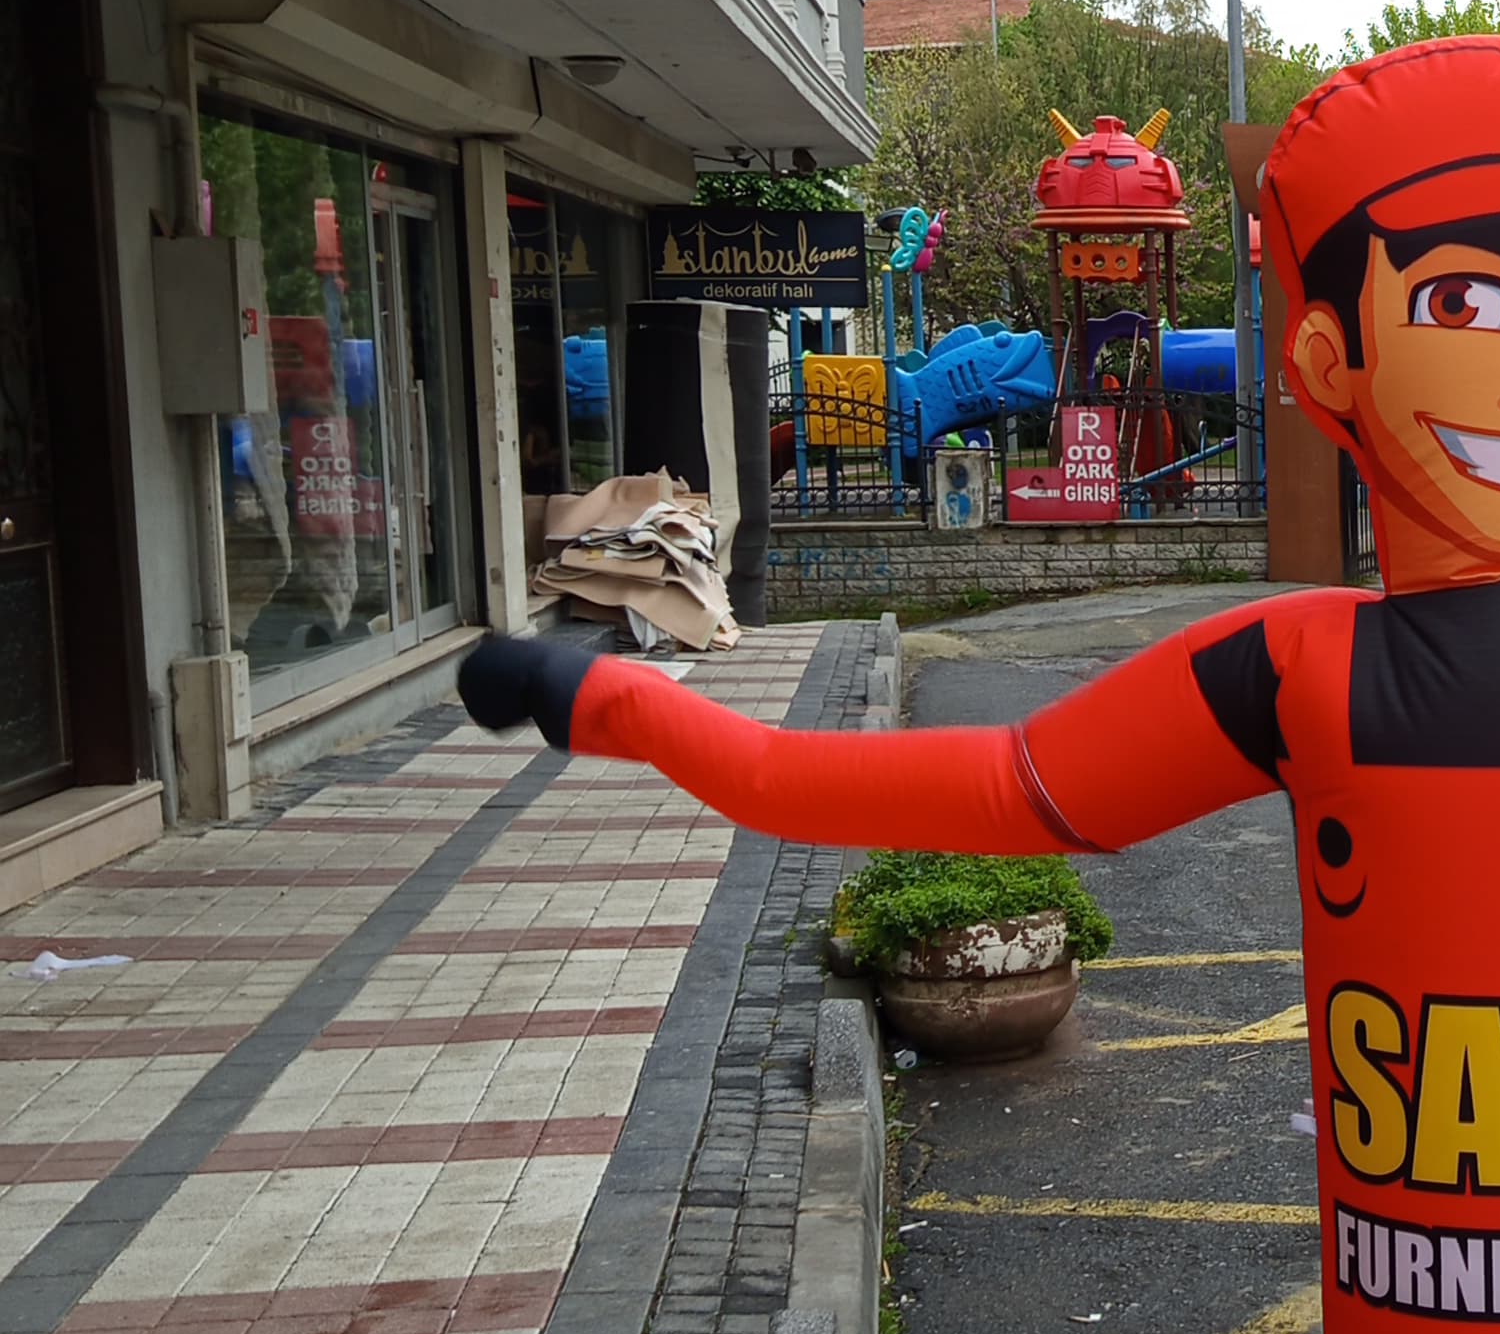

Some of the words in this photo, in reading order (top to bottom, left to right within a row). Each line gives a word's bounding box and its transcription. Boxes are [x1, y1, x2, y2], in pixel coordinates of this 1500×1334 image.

[808, 245, 858, 264] home
[703, 282, 777, 298] dekoratif
[782, 283, 813, 298] halı
[1067, 445, 1112, 461] OTO
[1064, 463, 1115, 479] PARK
[1064, 482, 1116, 504] GİRİŞ!
